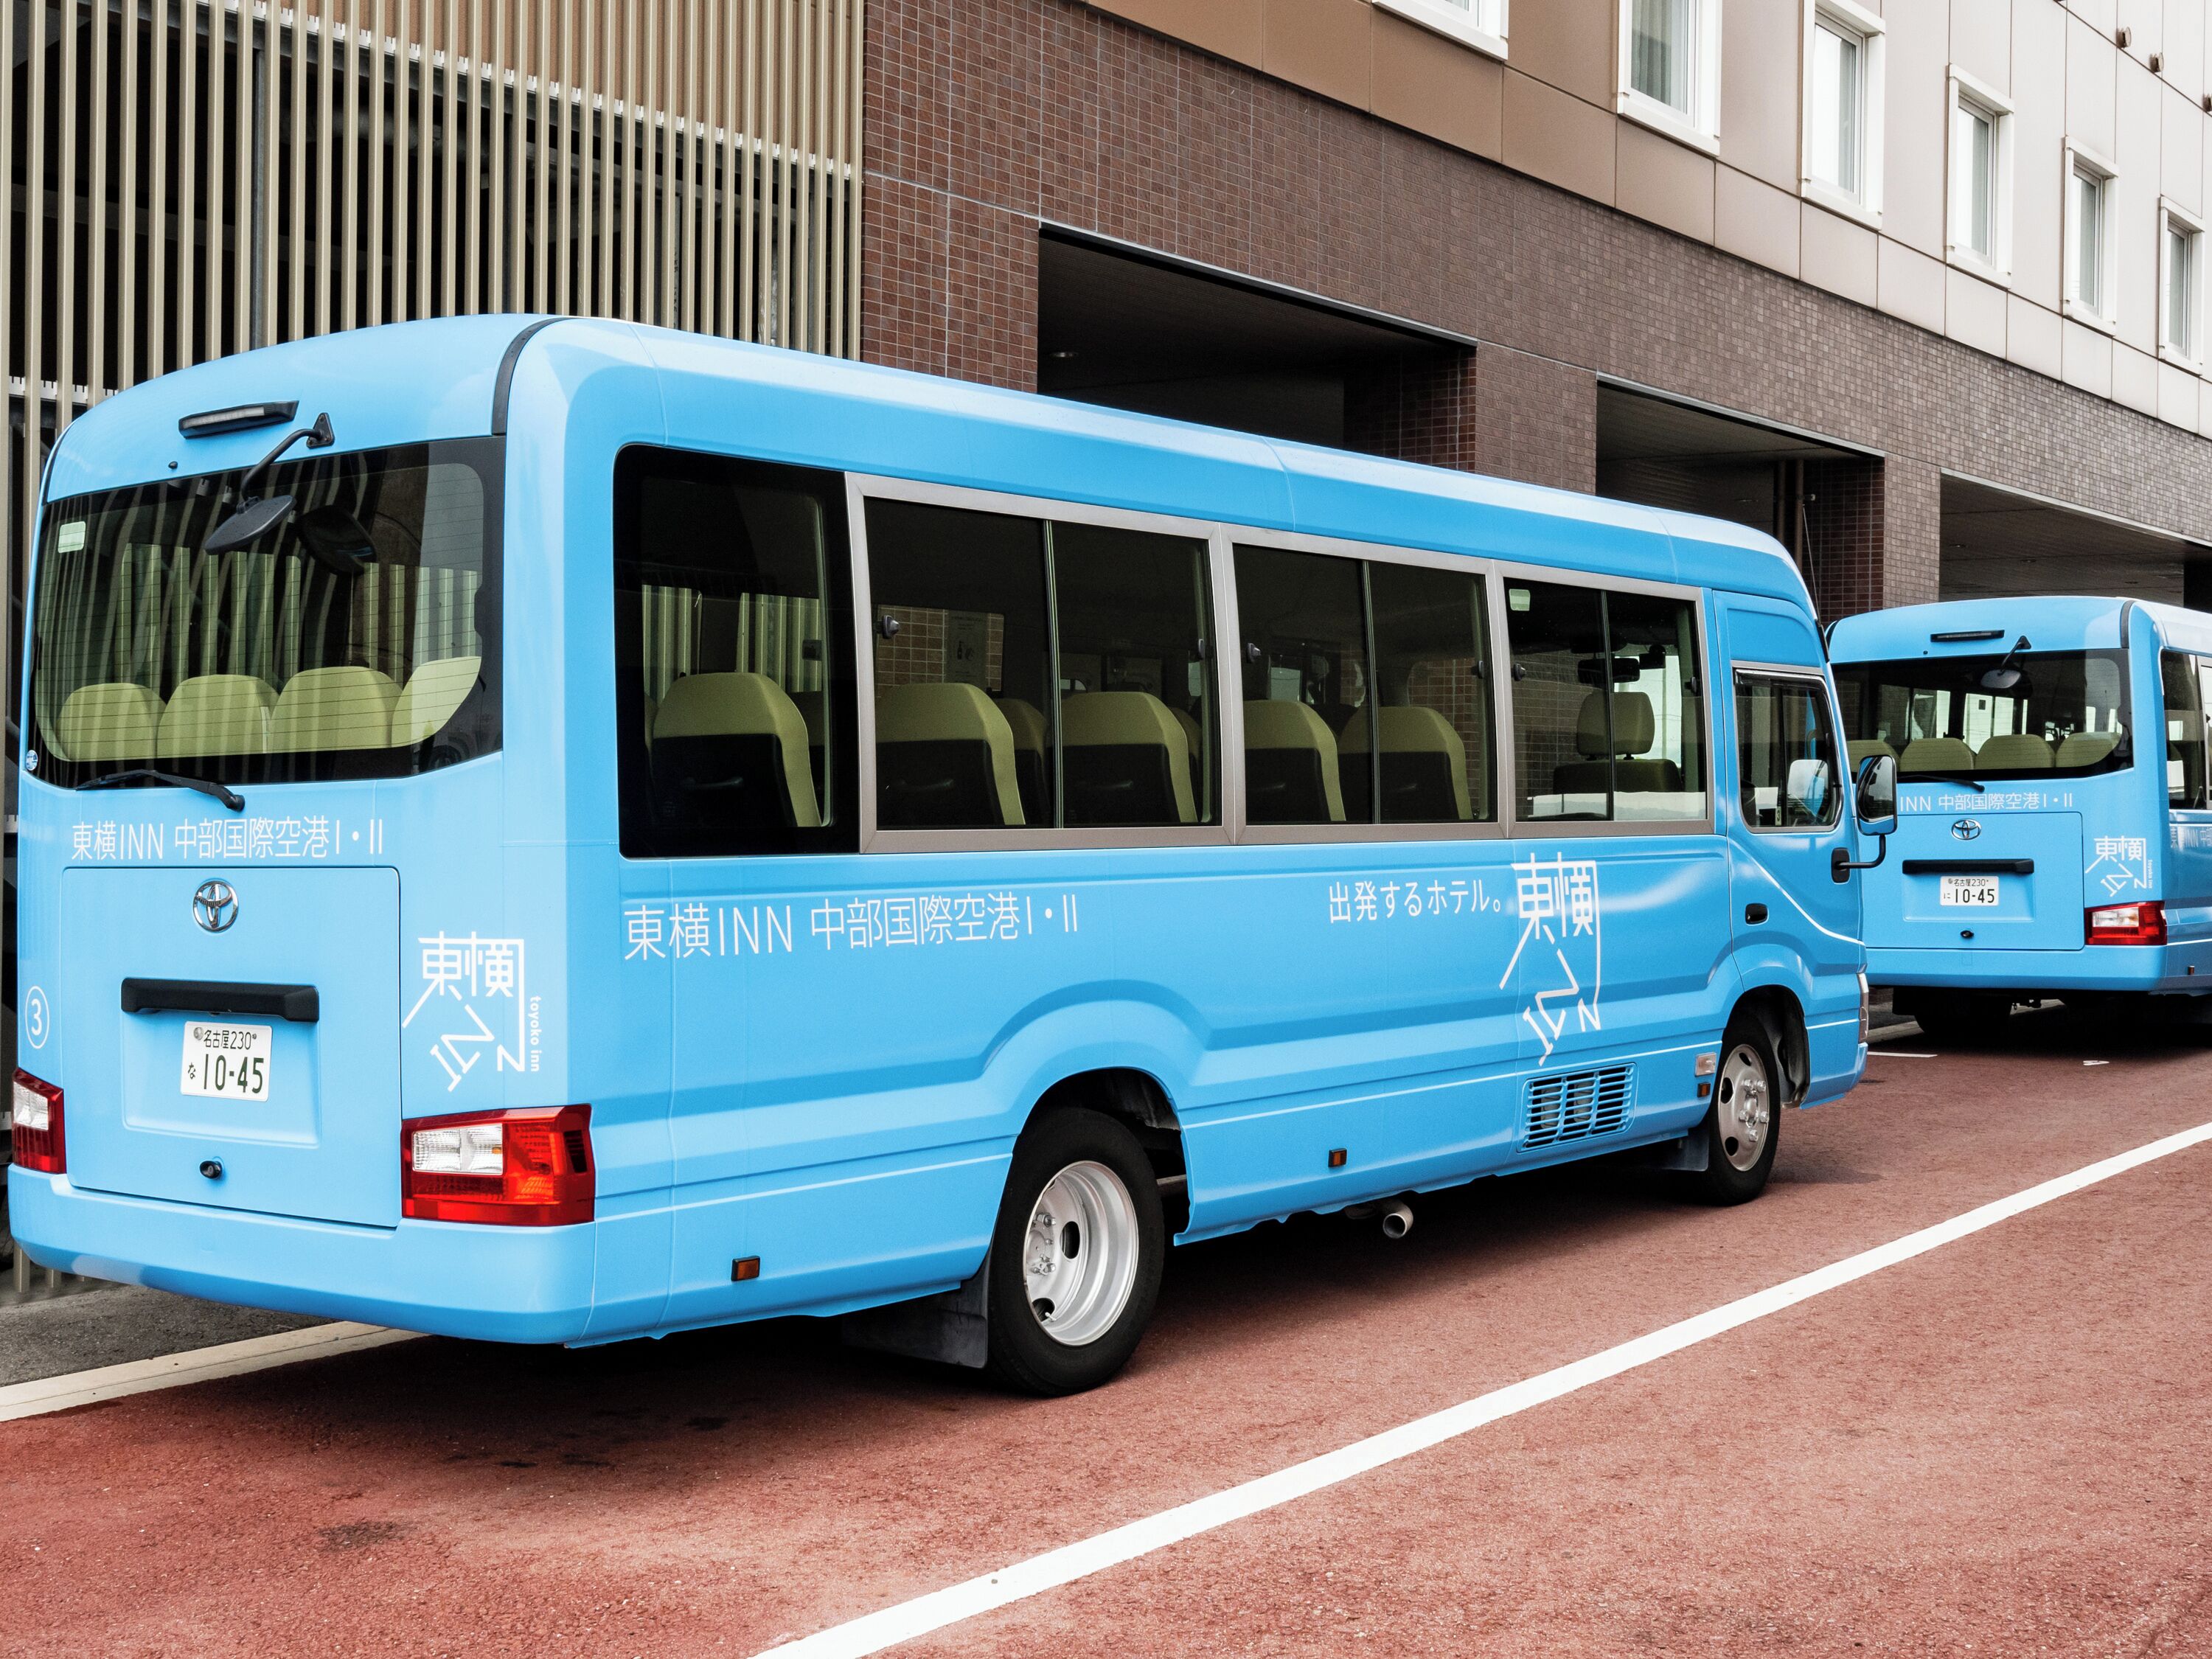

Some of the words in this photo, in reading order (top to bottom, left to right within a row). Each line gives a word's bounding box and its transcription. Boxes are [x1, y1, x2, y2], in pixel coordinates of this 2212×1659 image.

[72, 821, 163, 861] 東横INN
[1329, 879, 1501, 924] 出発するホテル。
[1955, 888, 1994, 903] 10-45
[625, 902, 793, 961] 東横INN
[528, 995, 543, 1046] toyoko
[188, 1062, 196, 1079] な
[204, 1054, 264, 1094] 10-45
[530, 1050, 543, 1072] inn
